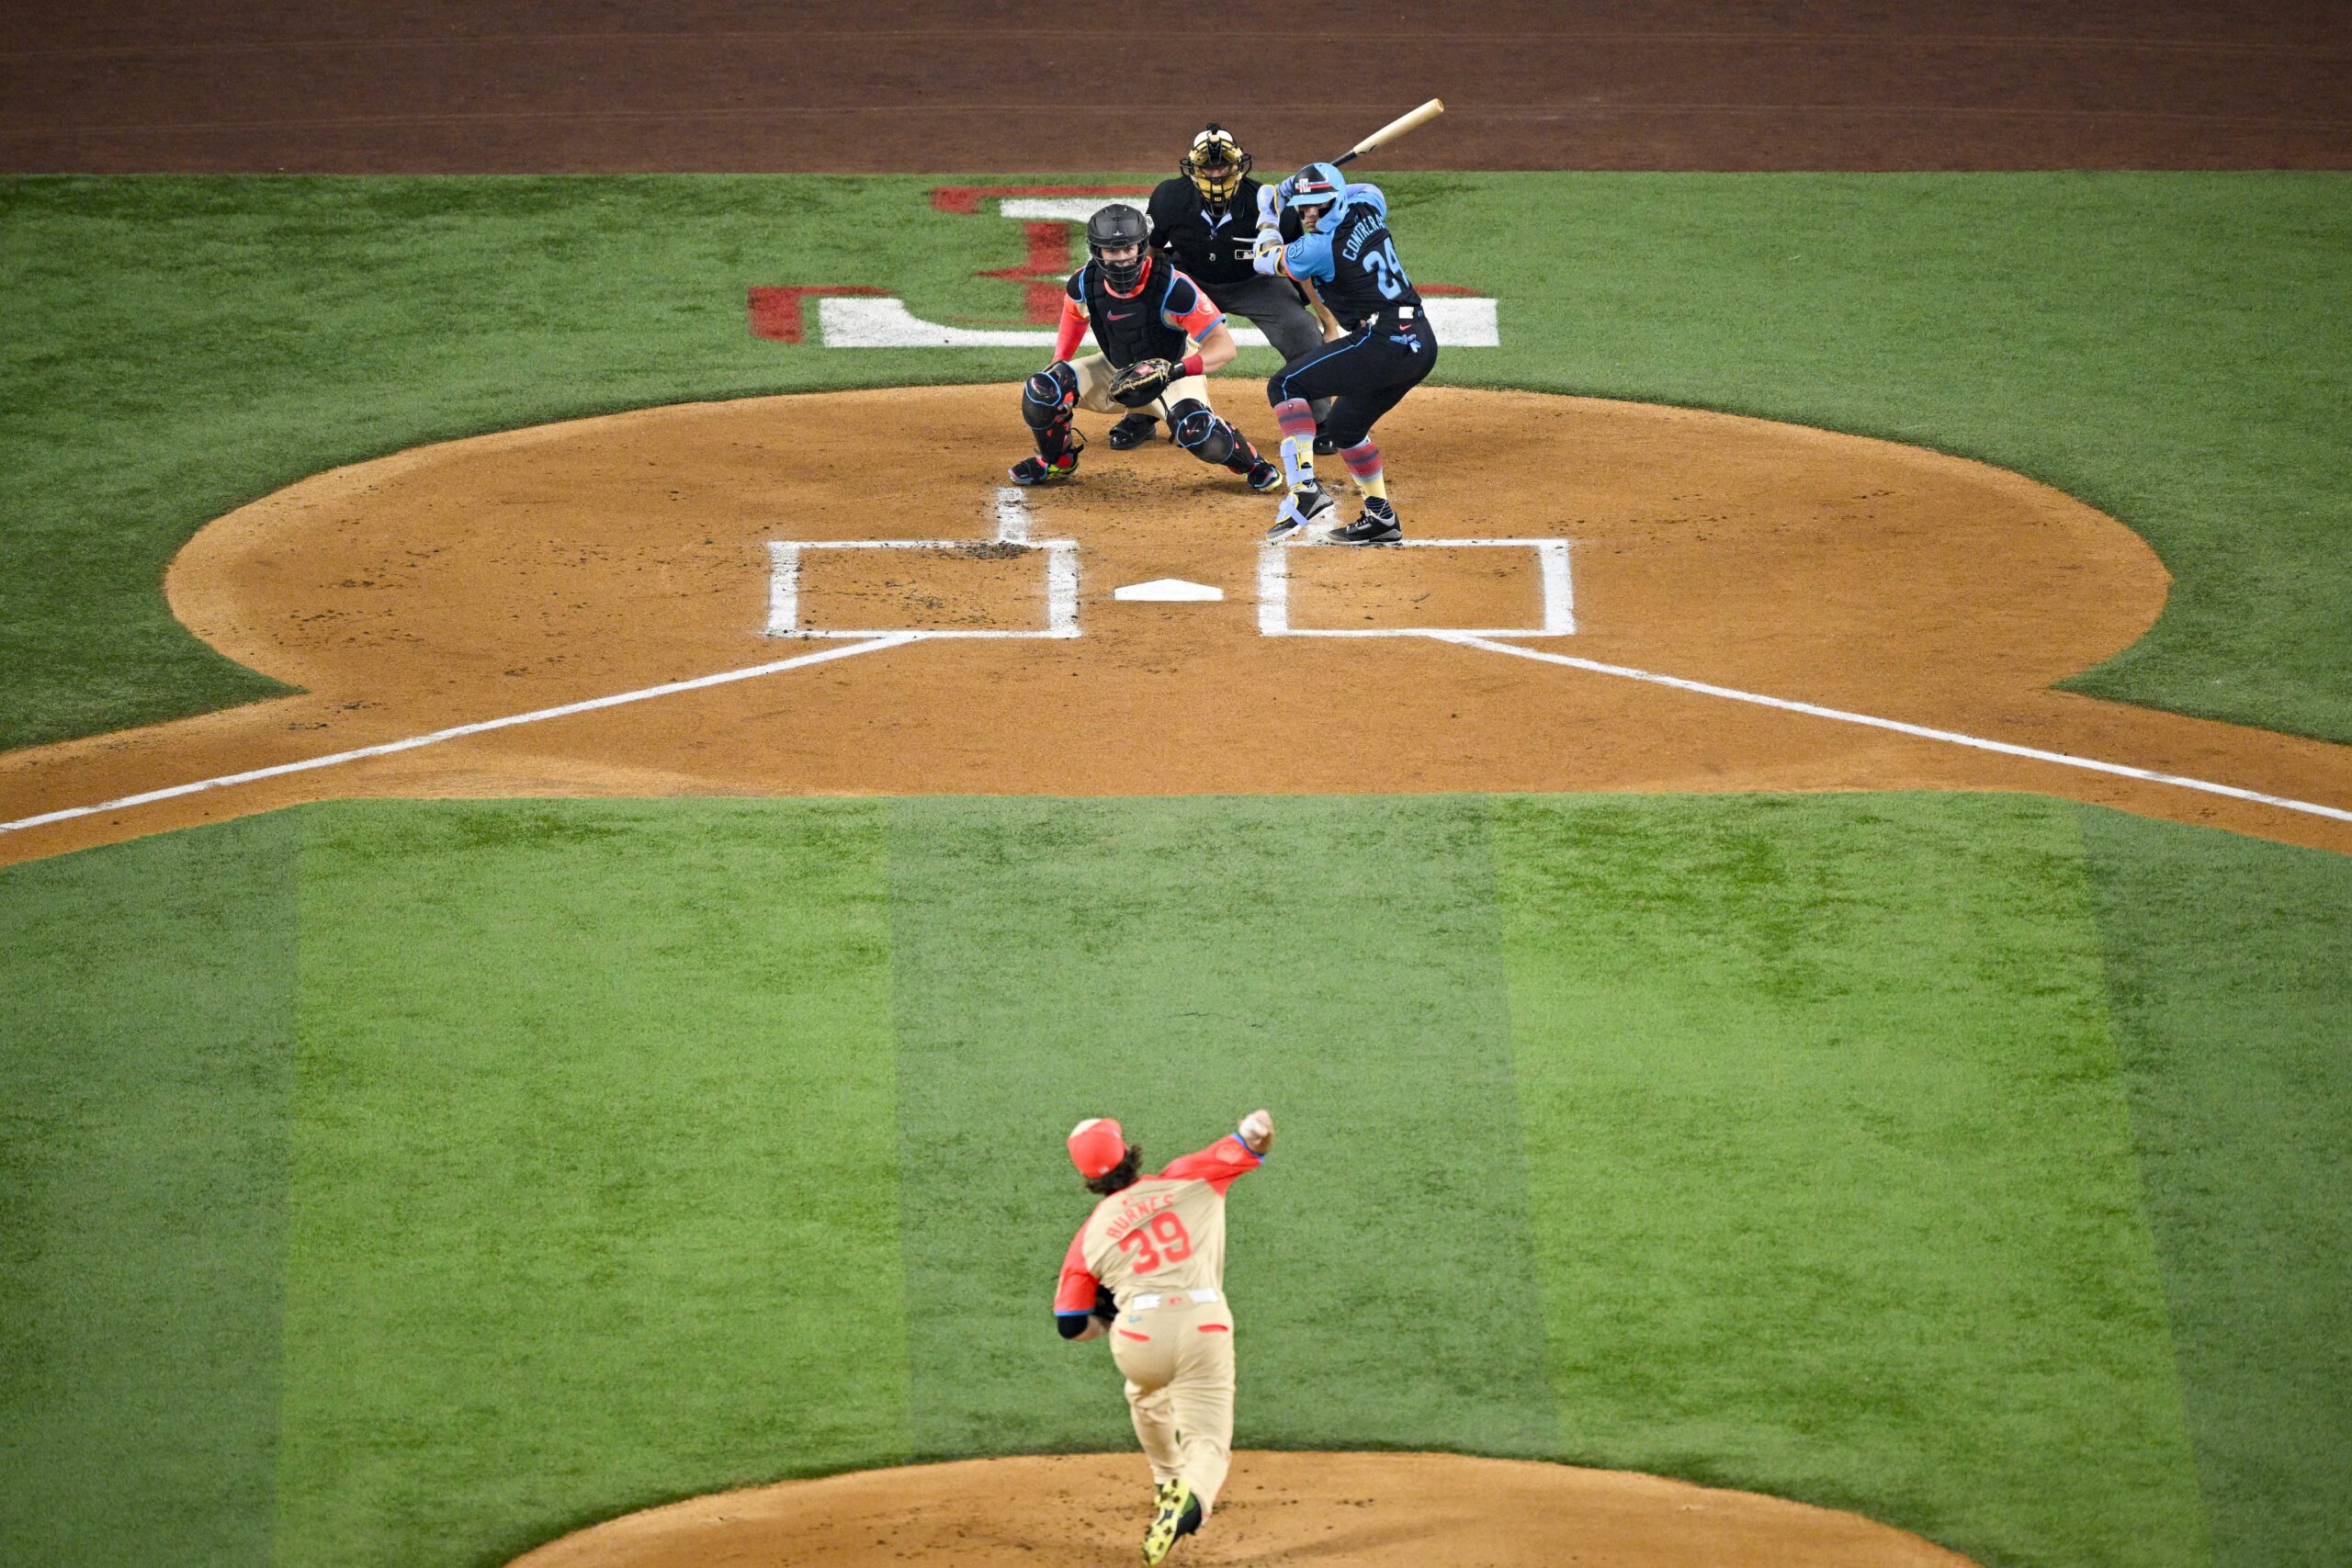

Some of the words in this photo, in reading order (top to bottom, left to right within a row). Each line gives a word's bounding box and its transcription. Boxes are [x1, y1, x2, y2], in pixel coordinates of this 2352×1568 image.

[1342, 213, 1387, 261] CONTRERA
[1363, 236, 1409, 299] 24
[1106, 1194, 1173, 1239] BURNES
[1118, 1211, 1192, 1275] 39
